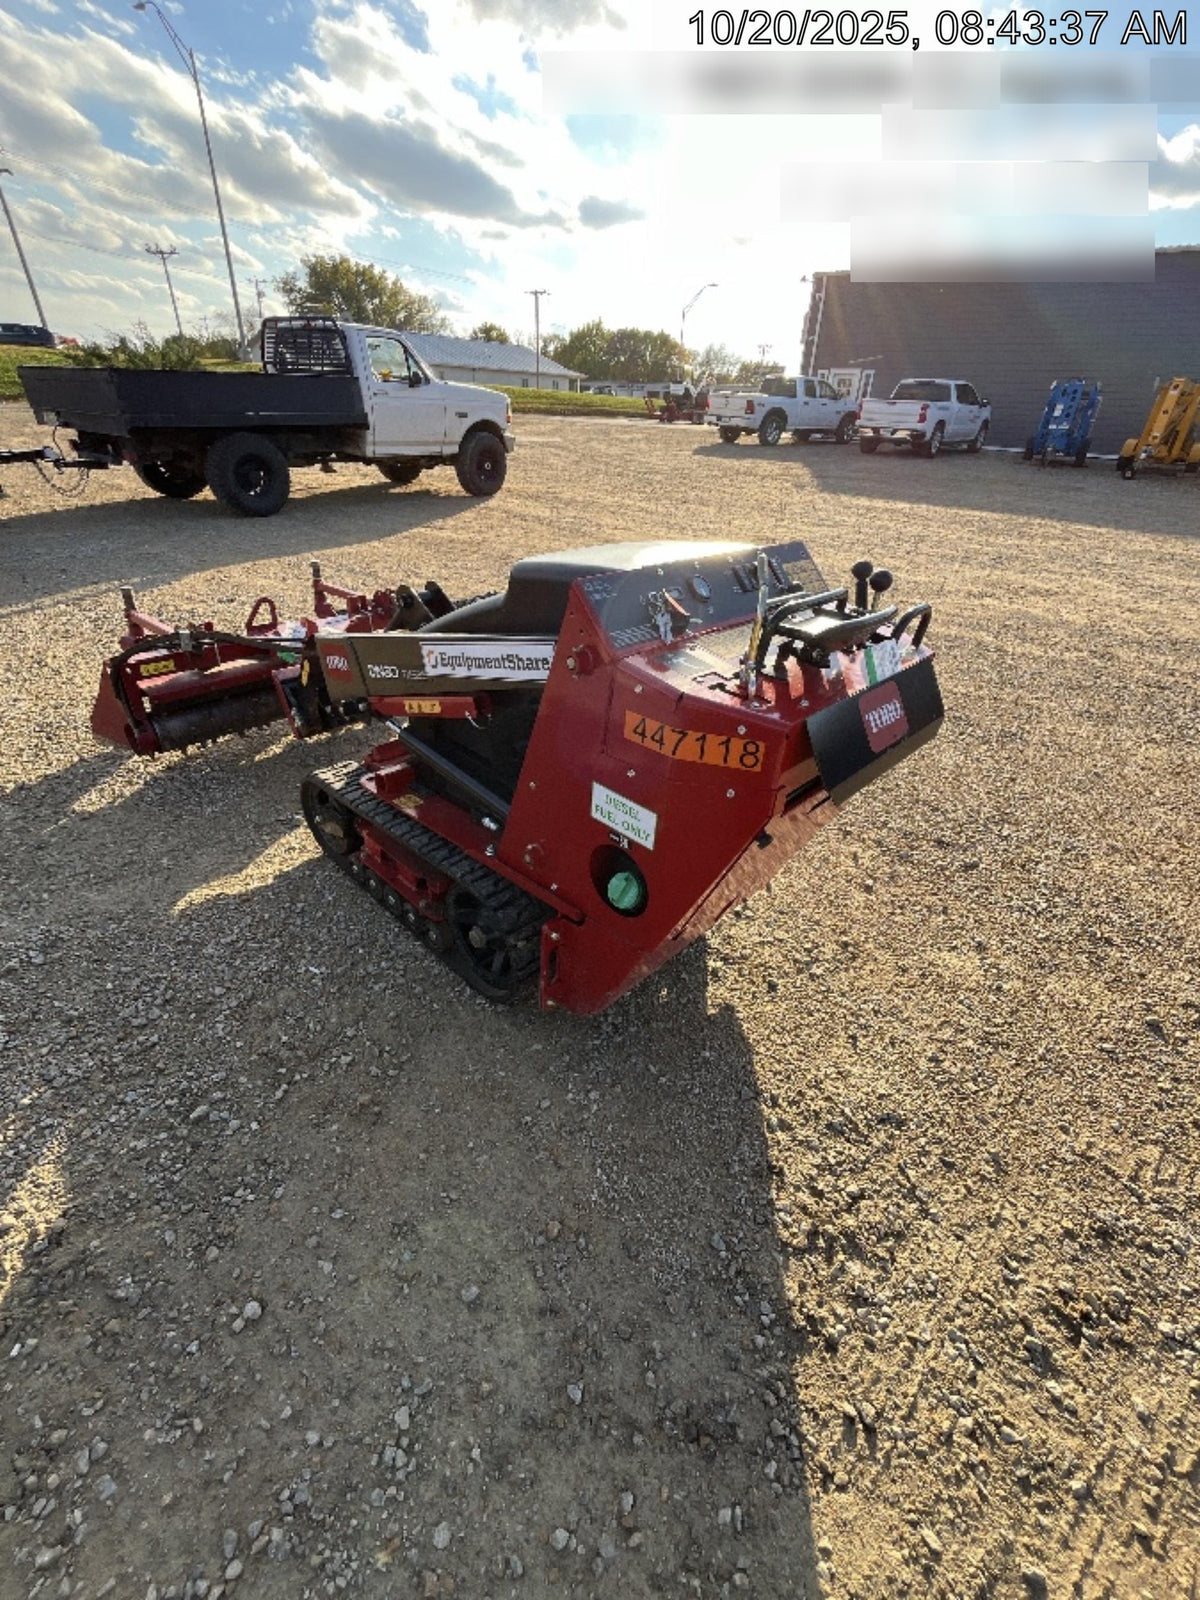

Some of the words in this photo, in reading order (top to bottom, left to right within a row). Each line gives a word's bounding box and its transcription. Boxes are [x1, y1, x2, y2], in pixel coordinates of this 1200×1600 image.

[438, 650, 550, 672] EquipmentShare
[632, 717, 760, 769] 447118
[595, 803, 619, 826] FUEL
[621, 820, 650, 842] ONLY
[605, 794, 640, 822] DIESEL
